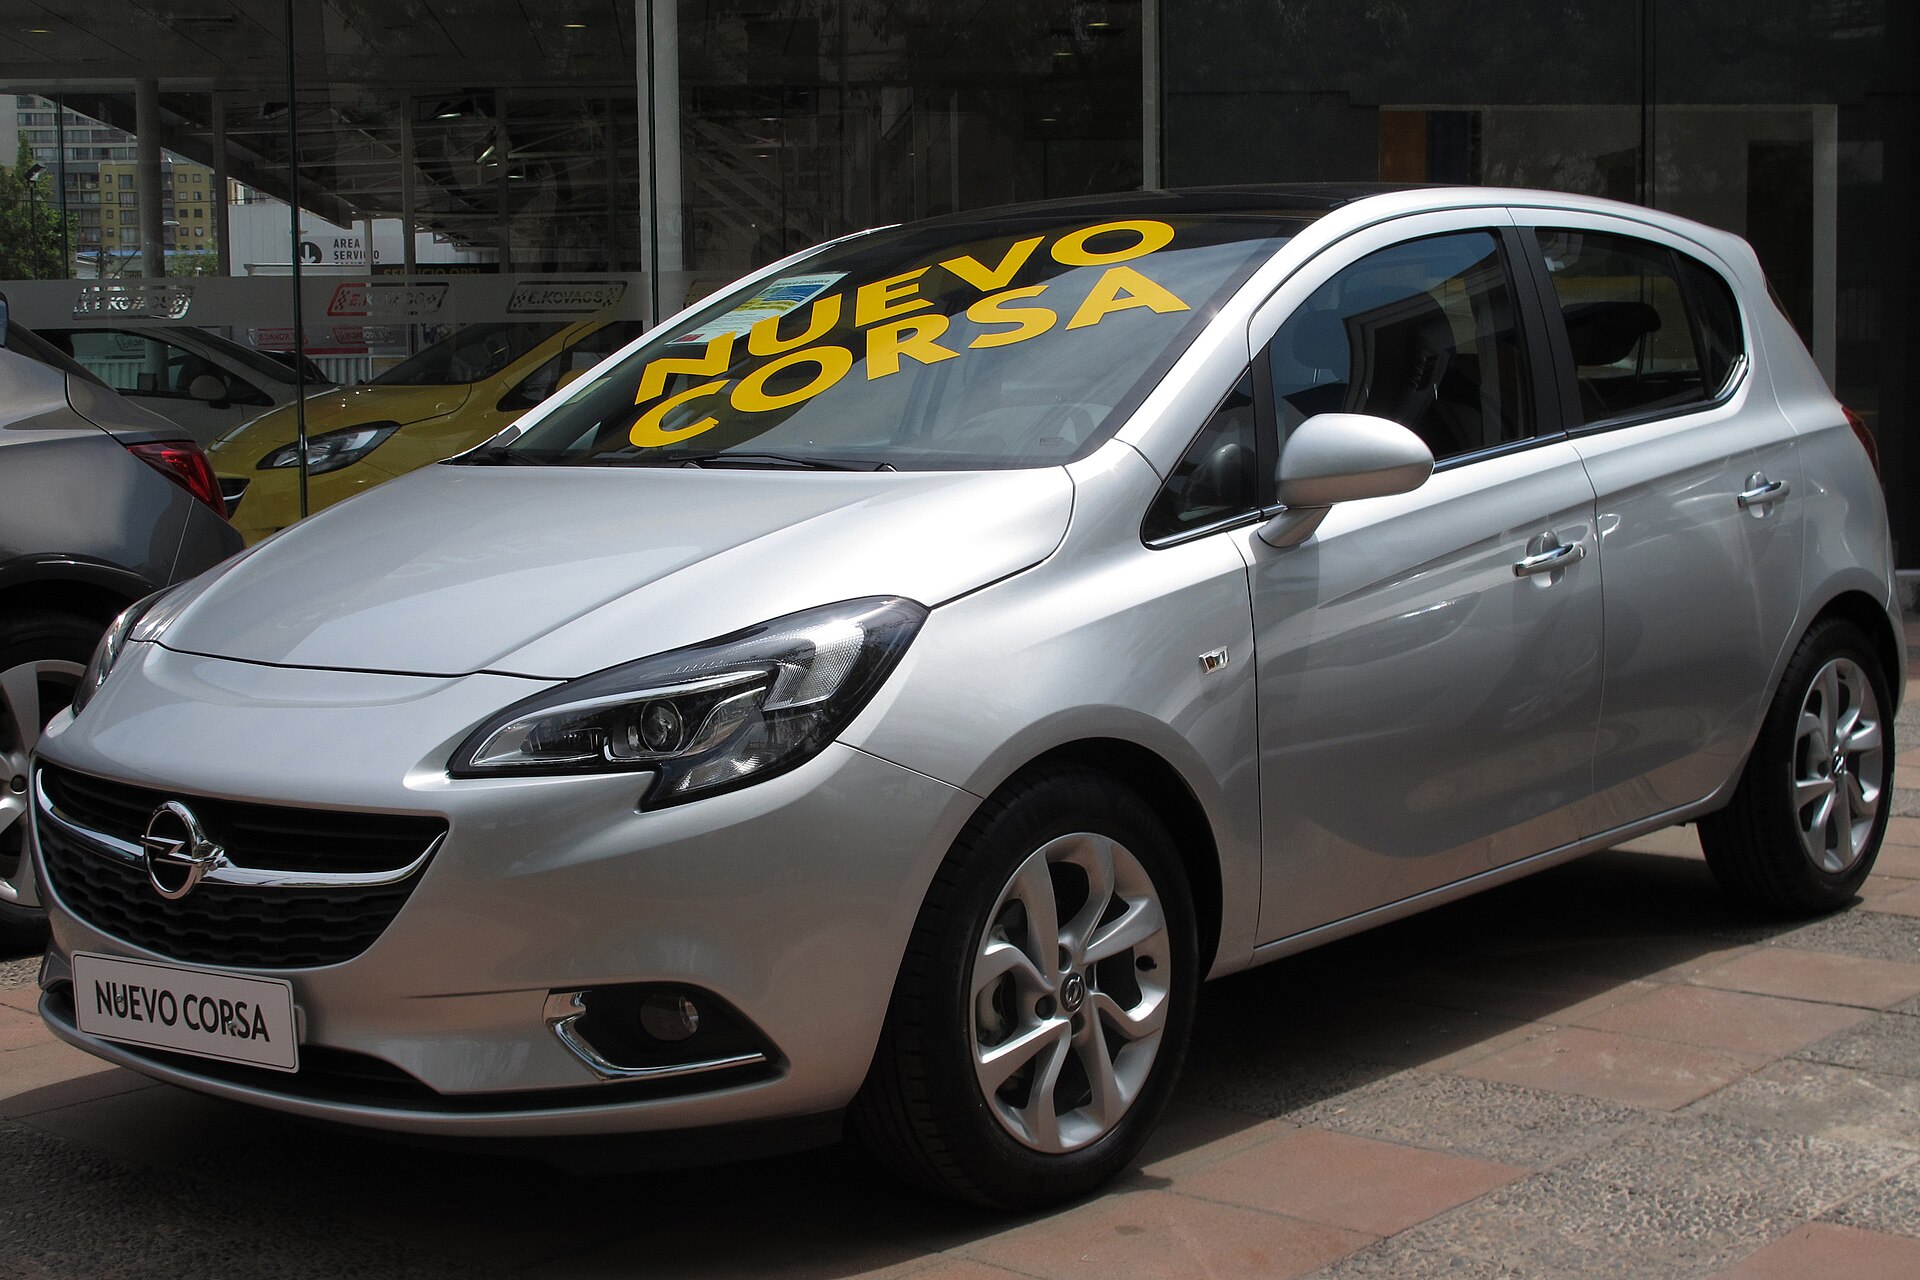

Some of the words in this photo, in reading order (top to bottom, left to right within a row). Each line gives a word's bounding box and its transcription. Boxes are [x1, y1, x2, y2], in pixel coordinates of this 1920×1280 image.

[333, 238, 360, 248] AREA
[333, 250, 380, 260] SERVIO
[527, 290, 604, 304] E.KOVACS
[635, 220, 1174, 404] NUEVO
[629, 268, 1190, 447] CORSA
[95, 980, 178, 1027] NUEVO
[183, 994, 271, 1043] CORSA
